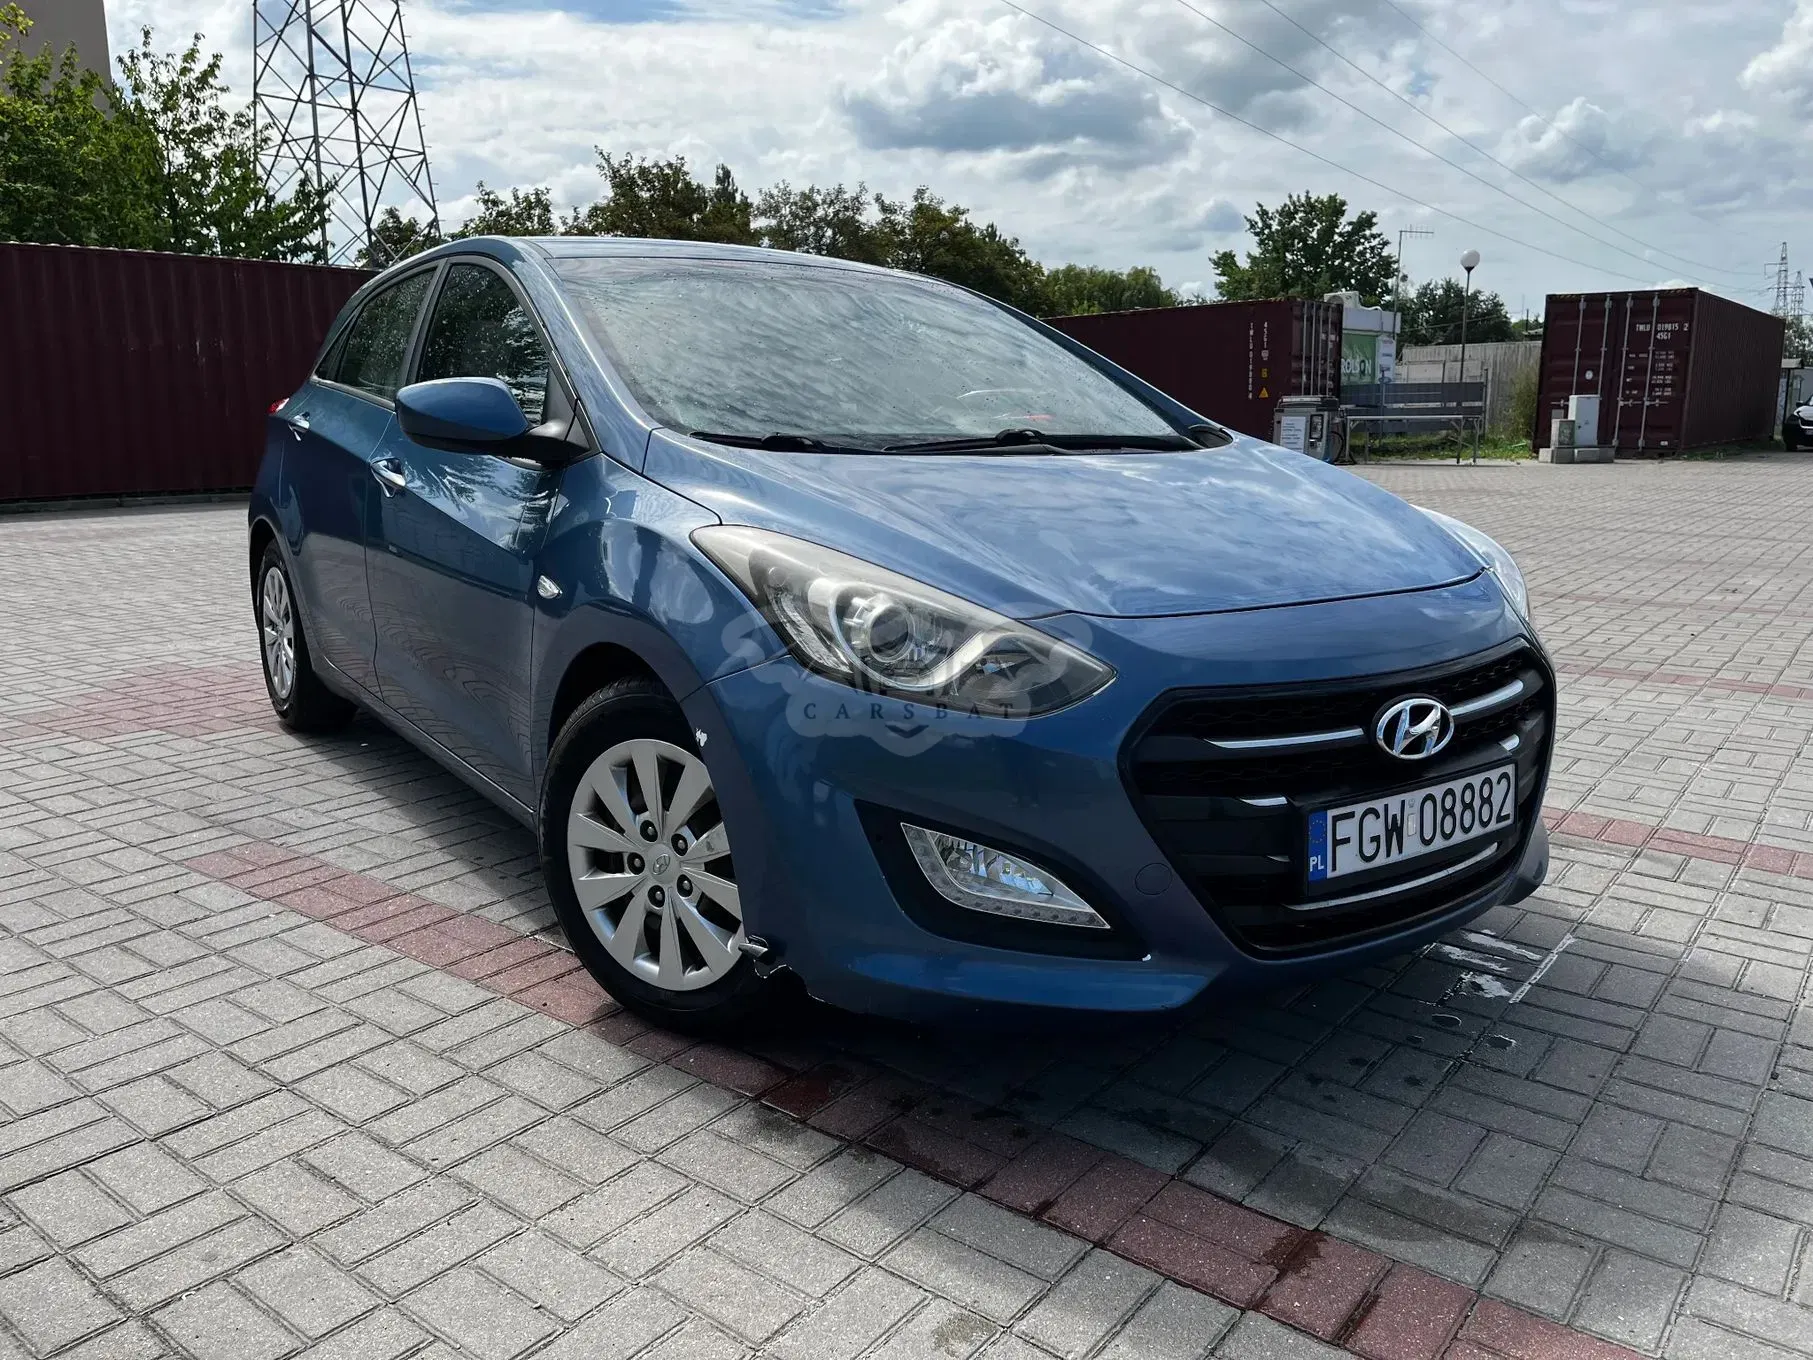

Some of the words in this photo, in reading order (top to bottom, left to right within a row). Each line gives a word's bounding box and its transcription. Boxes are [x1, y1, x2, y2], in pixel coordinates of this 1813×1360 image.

[1331, 799, 1405, 873] FGW
[1419, 771, 1512, 847] 08882
[1309, 856, 1325, 873] PL
